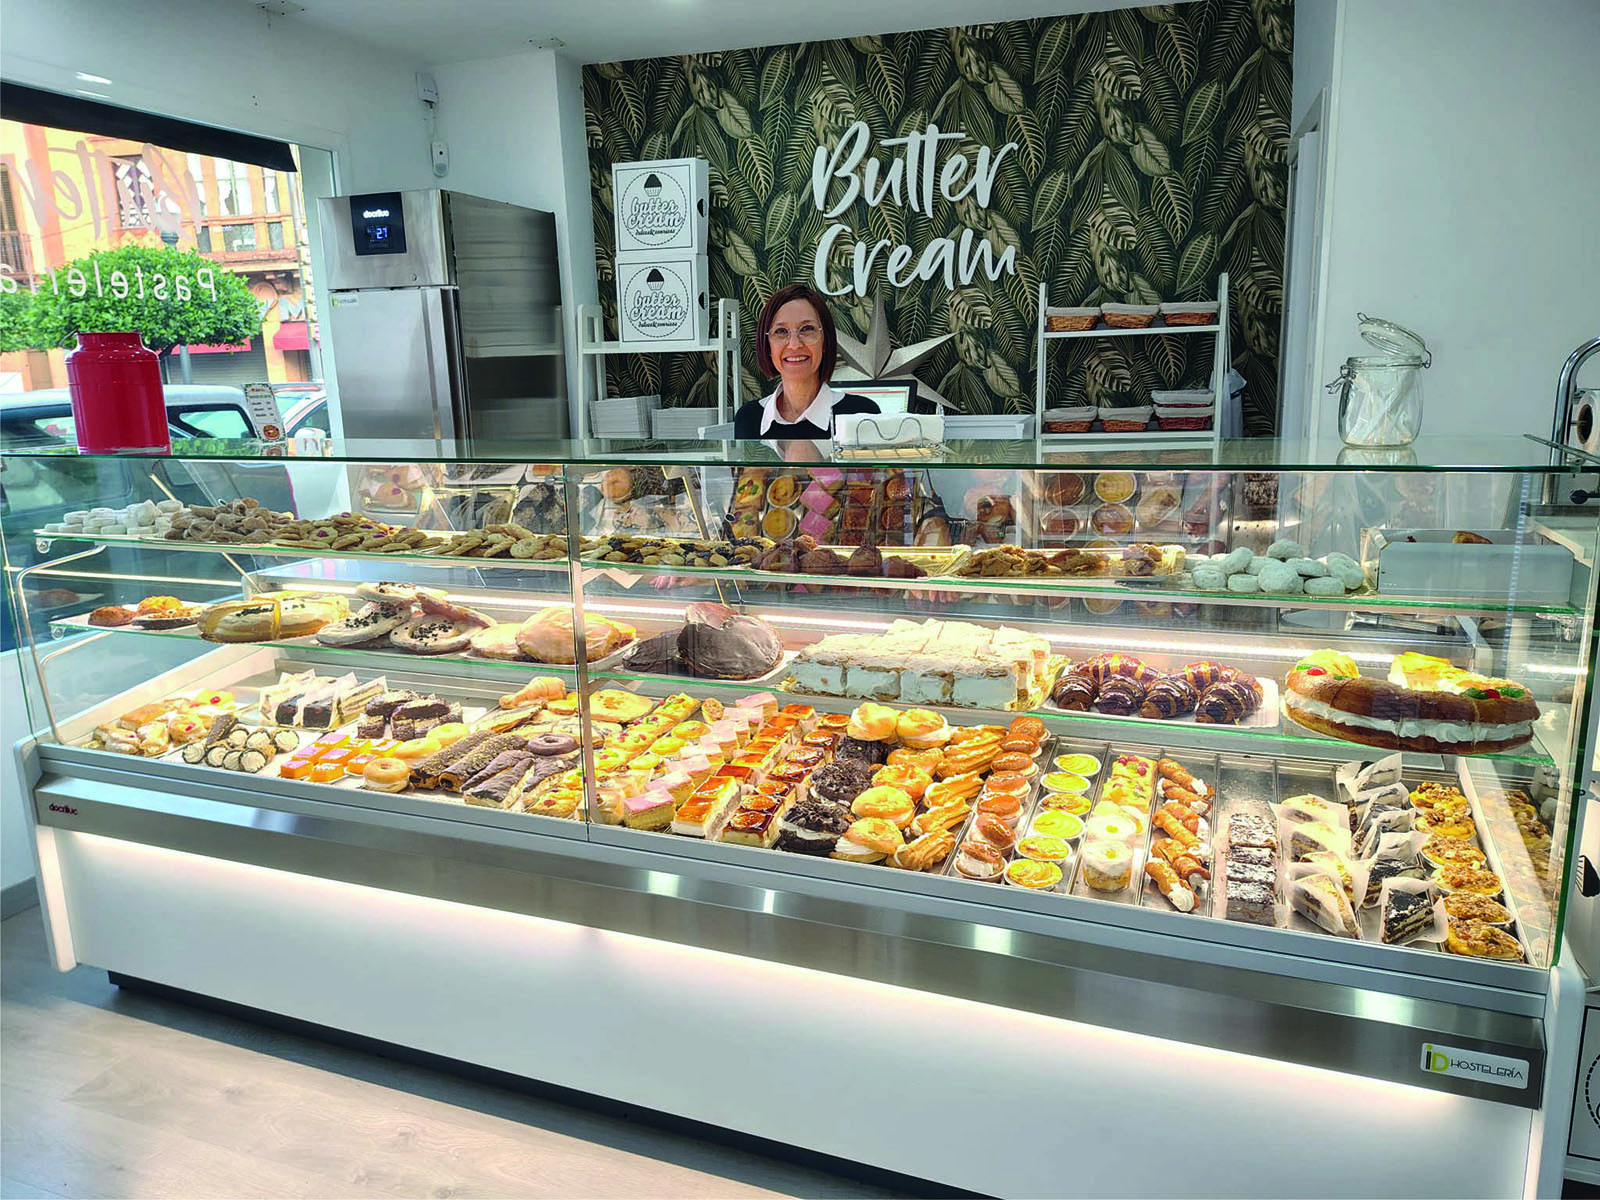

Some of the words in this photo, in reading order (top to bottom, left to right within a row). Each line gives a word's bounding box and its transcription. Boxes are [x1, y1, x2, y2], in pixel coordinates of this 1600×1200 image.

[812, 121, 1019, 219] Butter
[631, 196, 679, 214] butter
[627, 211, 684, 229] cream
[814, 224, 1017, 297] Cream
[634, 290, 681, 308] butter
[630, 305, 686, 322] cream
